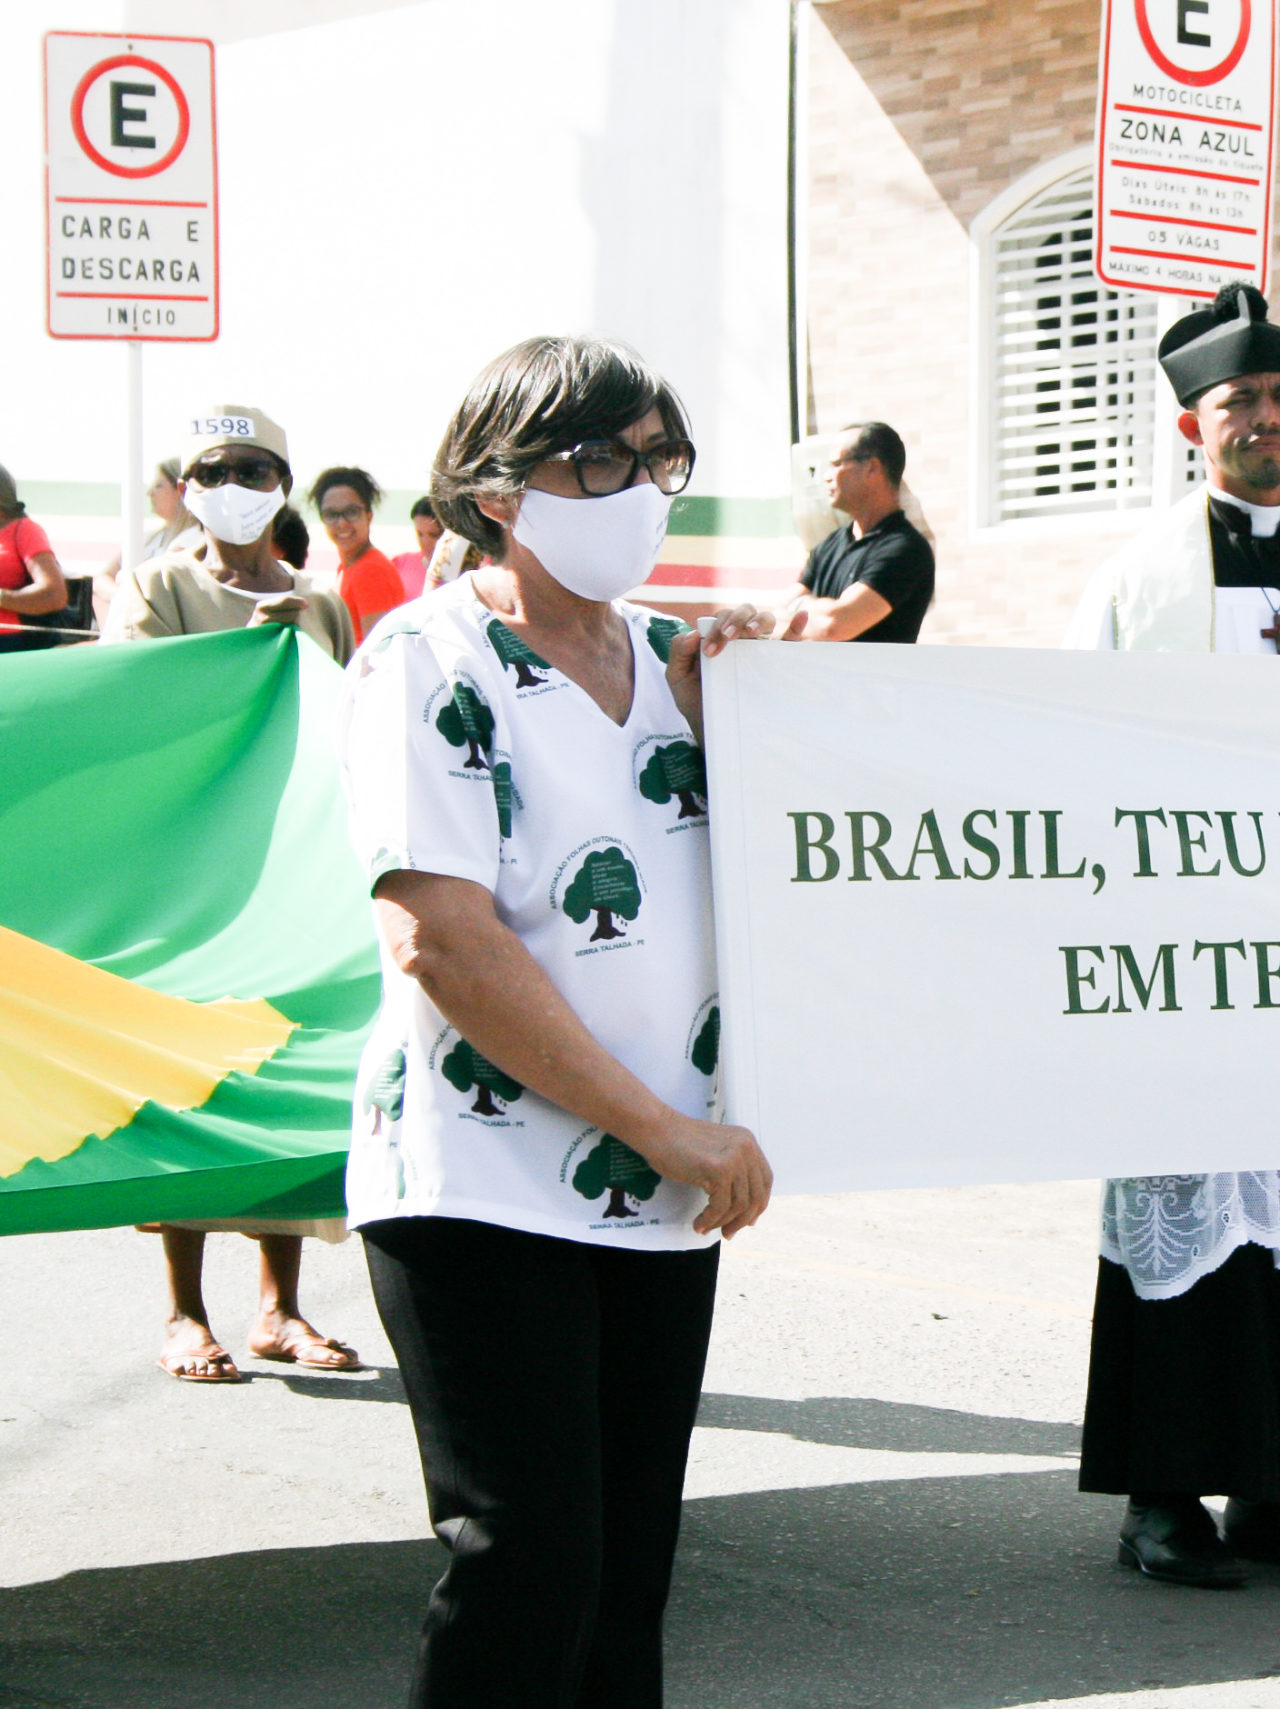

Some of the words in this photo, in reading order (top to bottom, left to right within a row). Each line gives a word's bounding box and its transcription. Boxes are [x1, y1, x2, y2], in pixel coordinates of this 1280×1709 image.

[1133, 84, 1242, 112] MOTOCICLETA
[110, 81, 156, 149] E
[1121, 119, 1182, 146] ZONA
[1199, 131, 1255, 156] AZUL
[61, 215, 150, 241] CARGA
[187, 220, 198, 242] E
[1148, 230, 1167, 243] 05
[1177, 234, 1219, 251] VAGAS
[62, 257, 200, 283] DESCARGA
[1168, 269, 1202, 282] HORAS
[107, 303, 175, 325] INÍCIO
[191, 418, 250, 436] 1598
[787, 807, 1106, 895] BRASIL,
[1114, 806, 1266, 878] TEU
[1058, 943, 1183, 1015] EM
